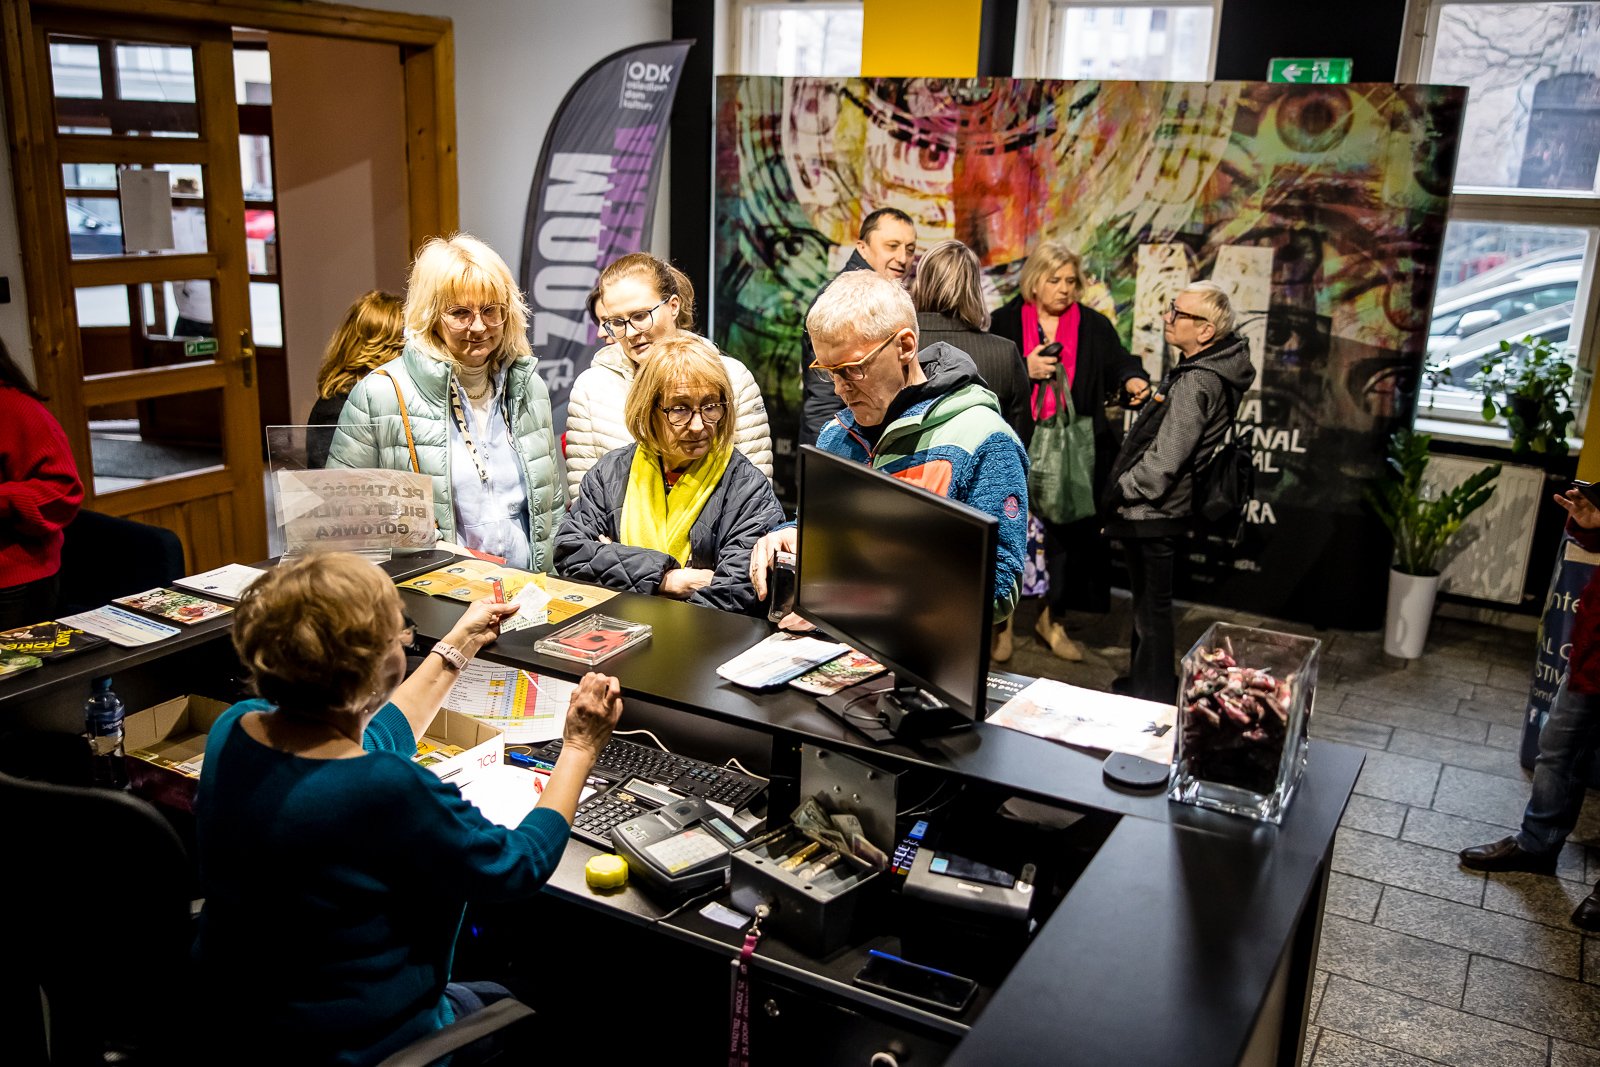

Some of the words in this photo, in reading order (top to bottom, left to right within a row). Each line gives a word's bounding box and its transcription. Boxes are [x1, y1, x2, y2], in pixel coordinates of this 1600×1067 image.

[628, 61, 674, 83] ODK
[534, 152, 617, 346] ZOOM
[1252, 448, 1280, 473] AL
[1535, 661, 1566, 686] STIV
